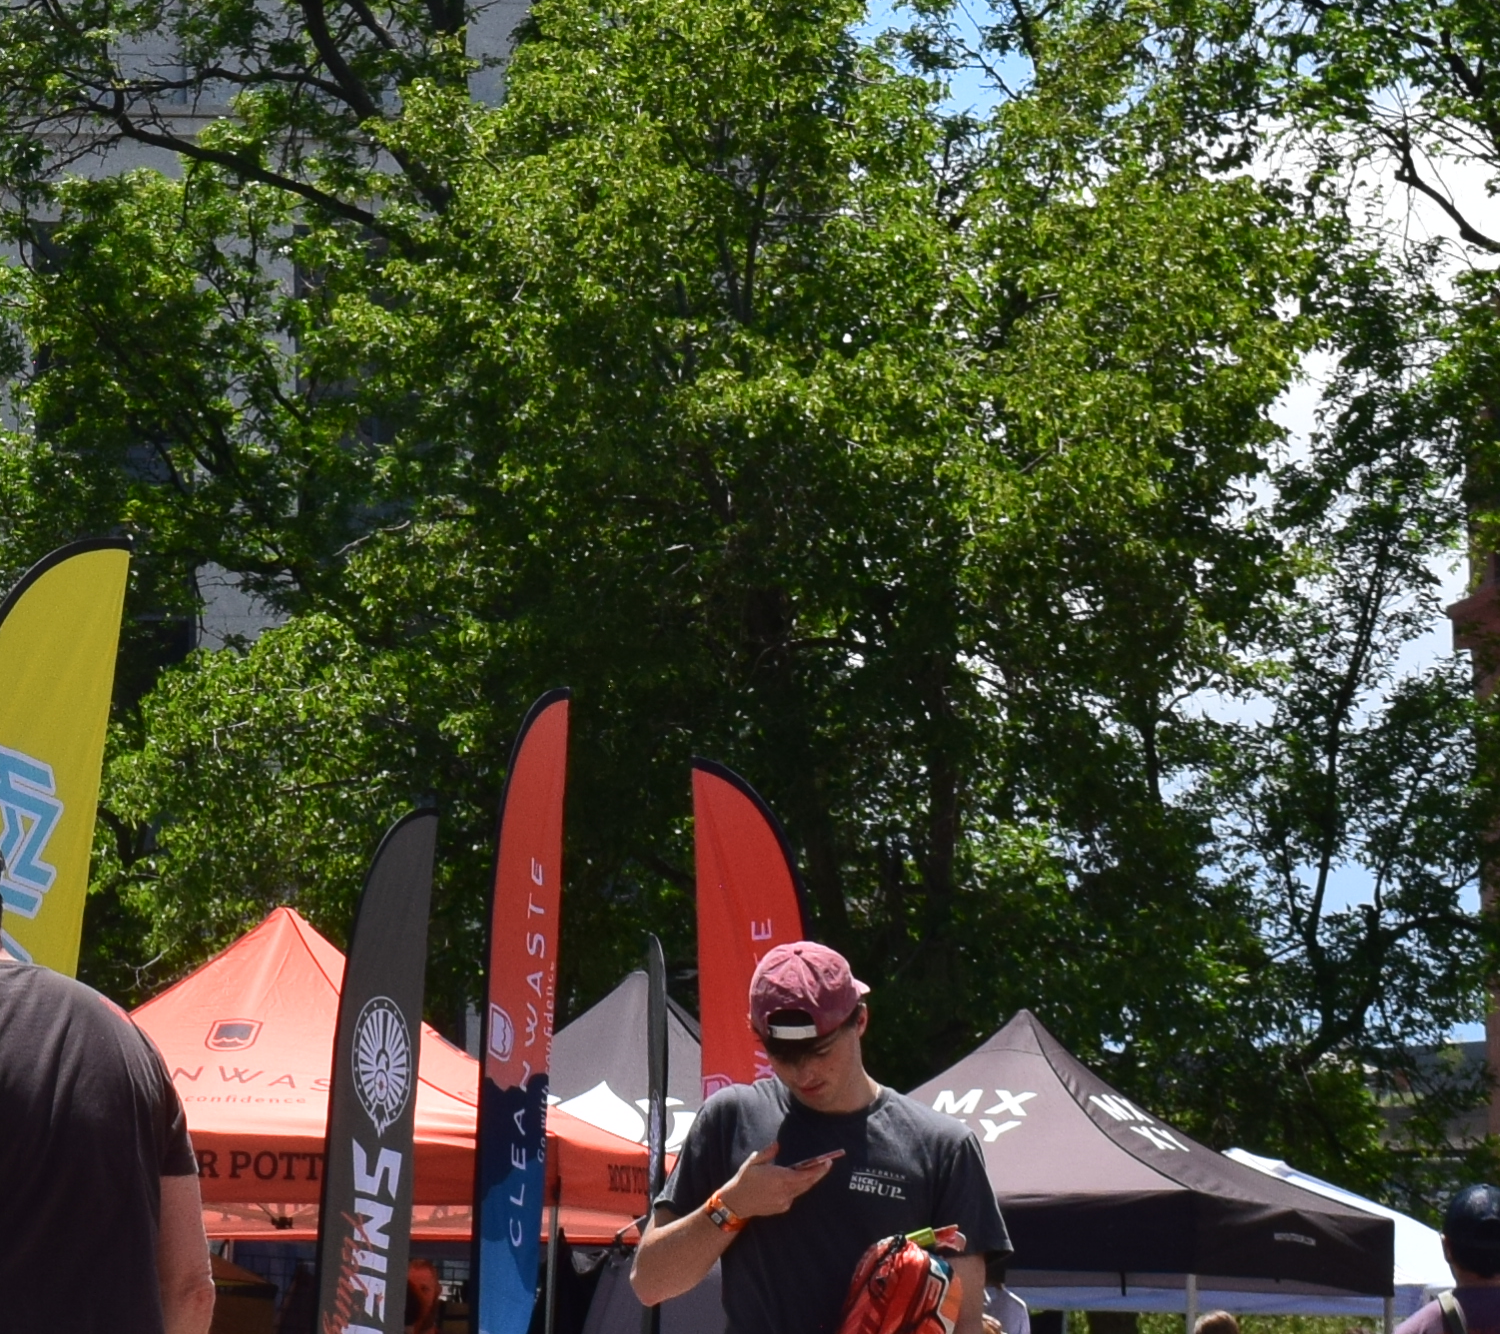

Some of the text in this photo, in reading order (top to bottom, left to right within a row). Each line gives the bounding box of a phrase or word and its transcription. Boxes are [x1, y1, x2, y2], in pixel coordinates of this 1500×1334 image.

[184, 1093, 308, 1105] confidence
[932, 1088, 1038, 1117] MX
[1089, 1093, 1155, 1125] MX
[1129, 1125, 1190, 1153] XY
[877, 1182, 903, 1198] UP
